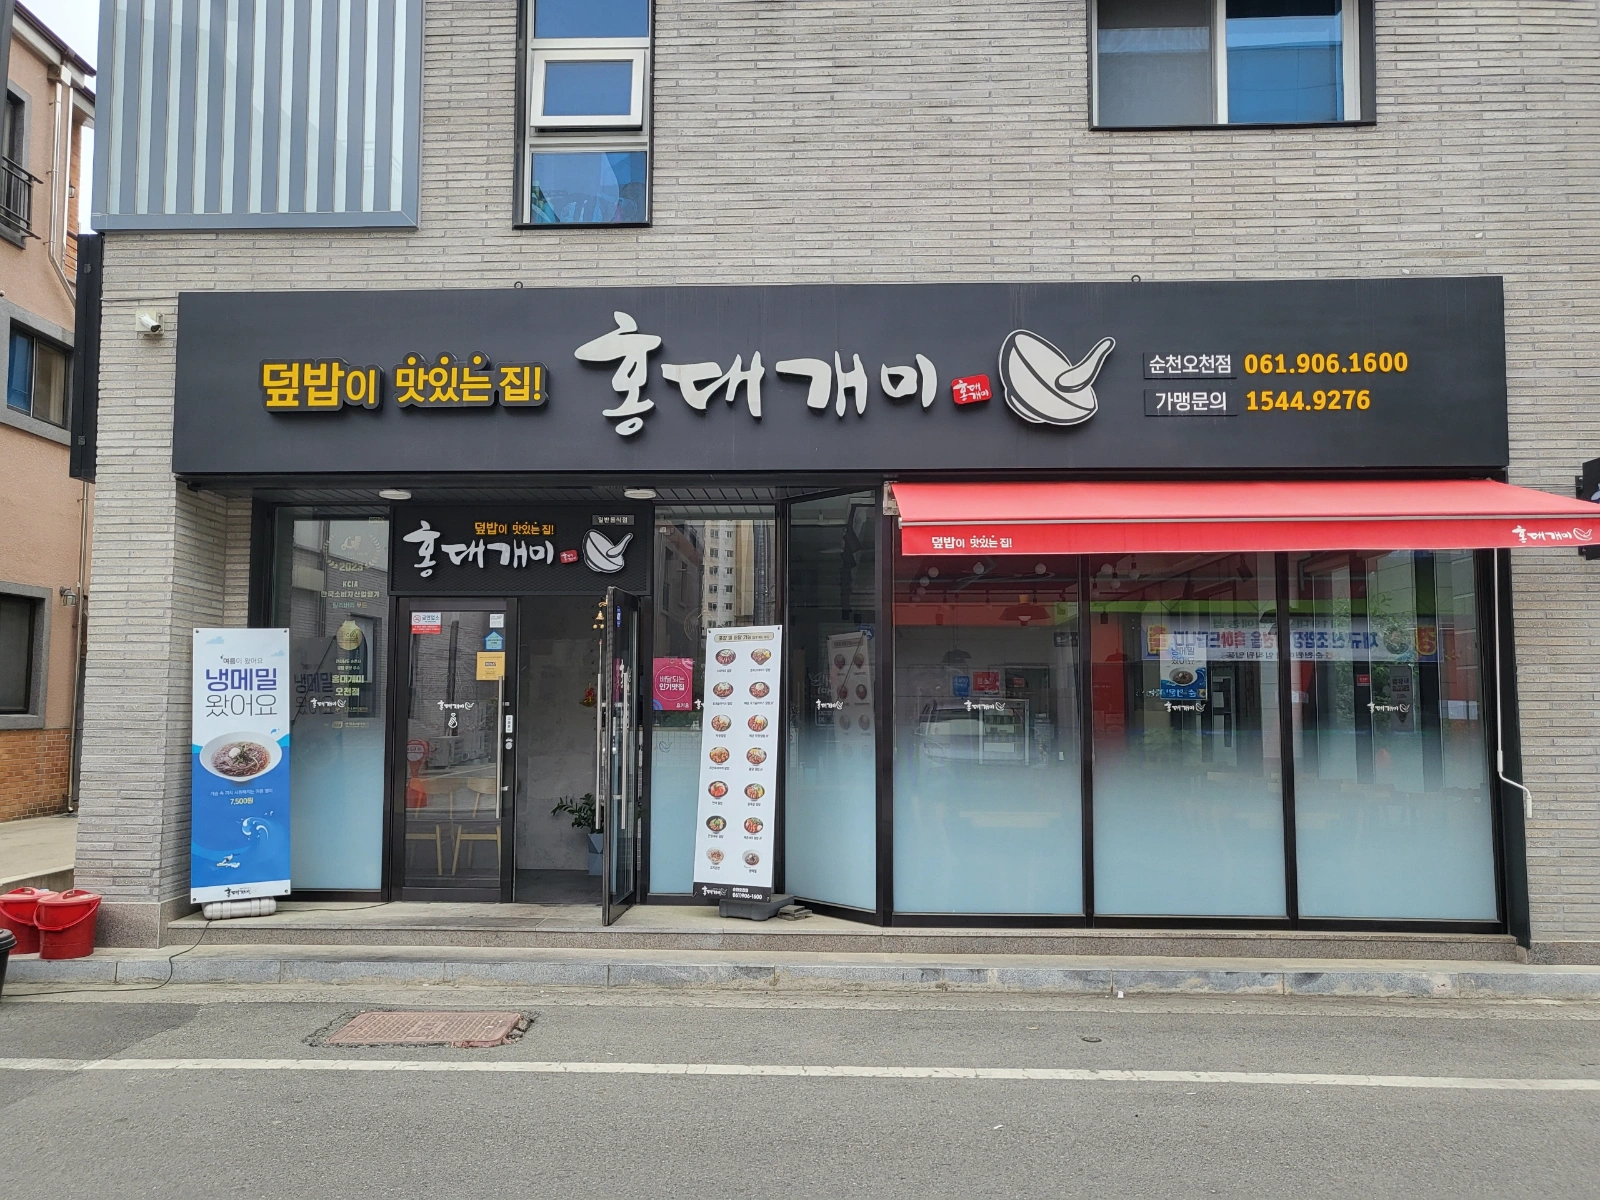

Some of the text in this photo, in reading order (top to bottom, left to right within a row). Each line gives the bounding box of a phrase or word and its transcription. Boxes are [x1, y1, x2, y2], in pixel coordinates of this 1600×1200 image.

[574, 311, 938, 435] 홍대개미
[1149, 354, 1232, 375] 순천오천점
[1244, 352, 1409, 375] 061.906.1600
[263, 356, 541, 408] 덮밥이 맛있는 집!
[1155, 390, 1229, 412] 가맹문의
[1246, 389, 1371, 412] 1544.9276
[474, 521, 554, 535] 덮밥이 맛있는 집!
[1511, 525, 1572, 544] 홍대개미
[402, 520, 554, 578] 홍대개미
[931, 535, 1012, 549] 덮밥이 맛있는 집!
[222, 657, 263, 665] 여름이 왔어요
[205, 667, 277, 692] 냉메밀
[659, 675, 685, 684] 배달되는
[659, 683, 685, 691] 인기맛집
[205, 693, 278, 718] 왔어요
[230, 797, 254, 806] 7,500원
